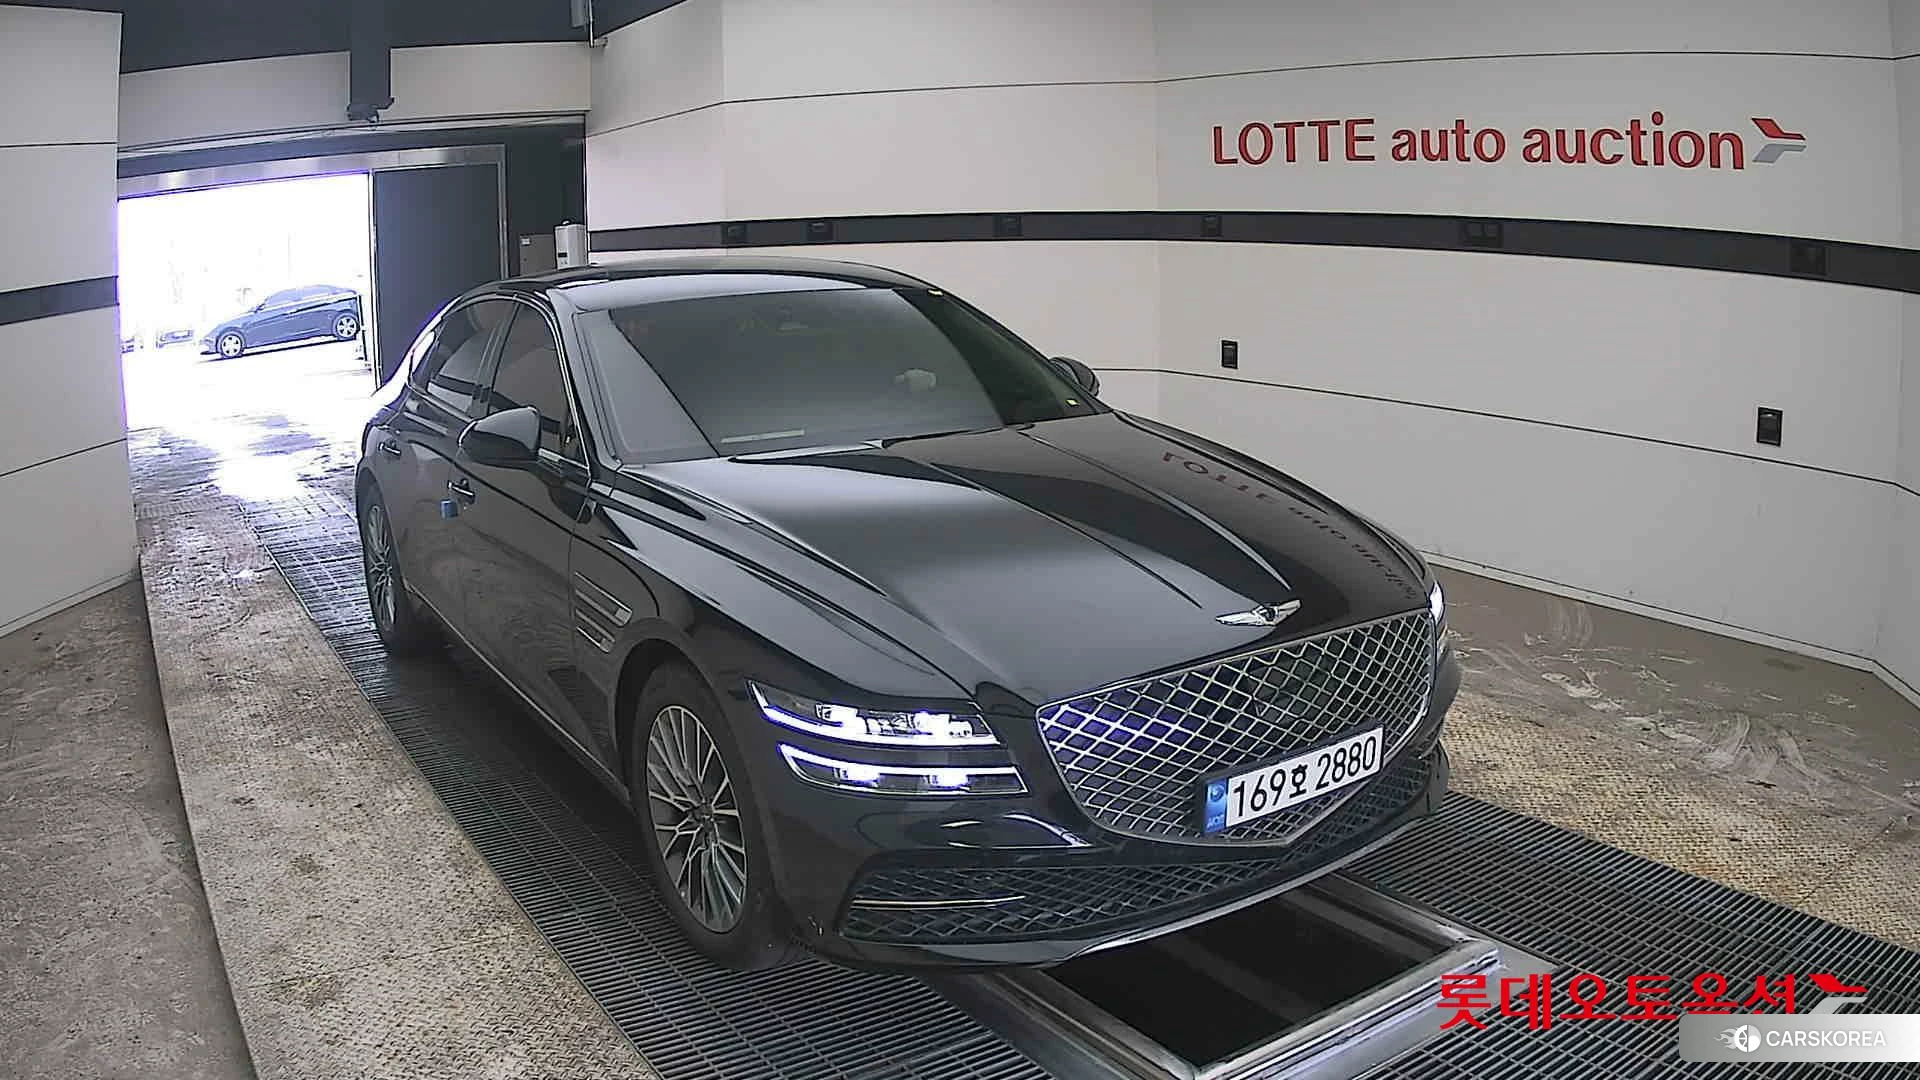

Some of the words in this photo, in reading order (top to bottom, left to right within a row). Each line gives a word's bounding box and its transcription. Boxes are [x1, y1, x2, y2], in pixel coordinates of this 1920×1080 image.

[1211, 117, 1377, 166] LOTTE
[1391, 118, 1507, 163] auto
[1522, 110, 1746, 170] auction
[1233, 763, 1309, 817] 169호
[1315, 735, 1378, 791] 2880
